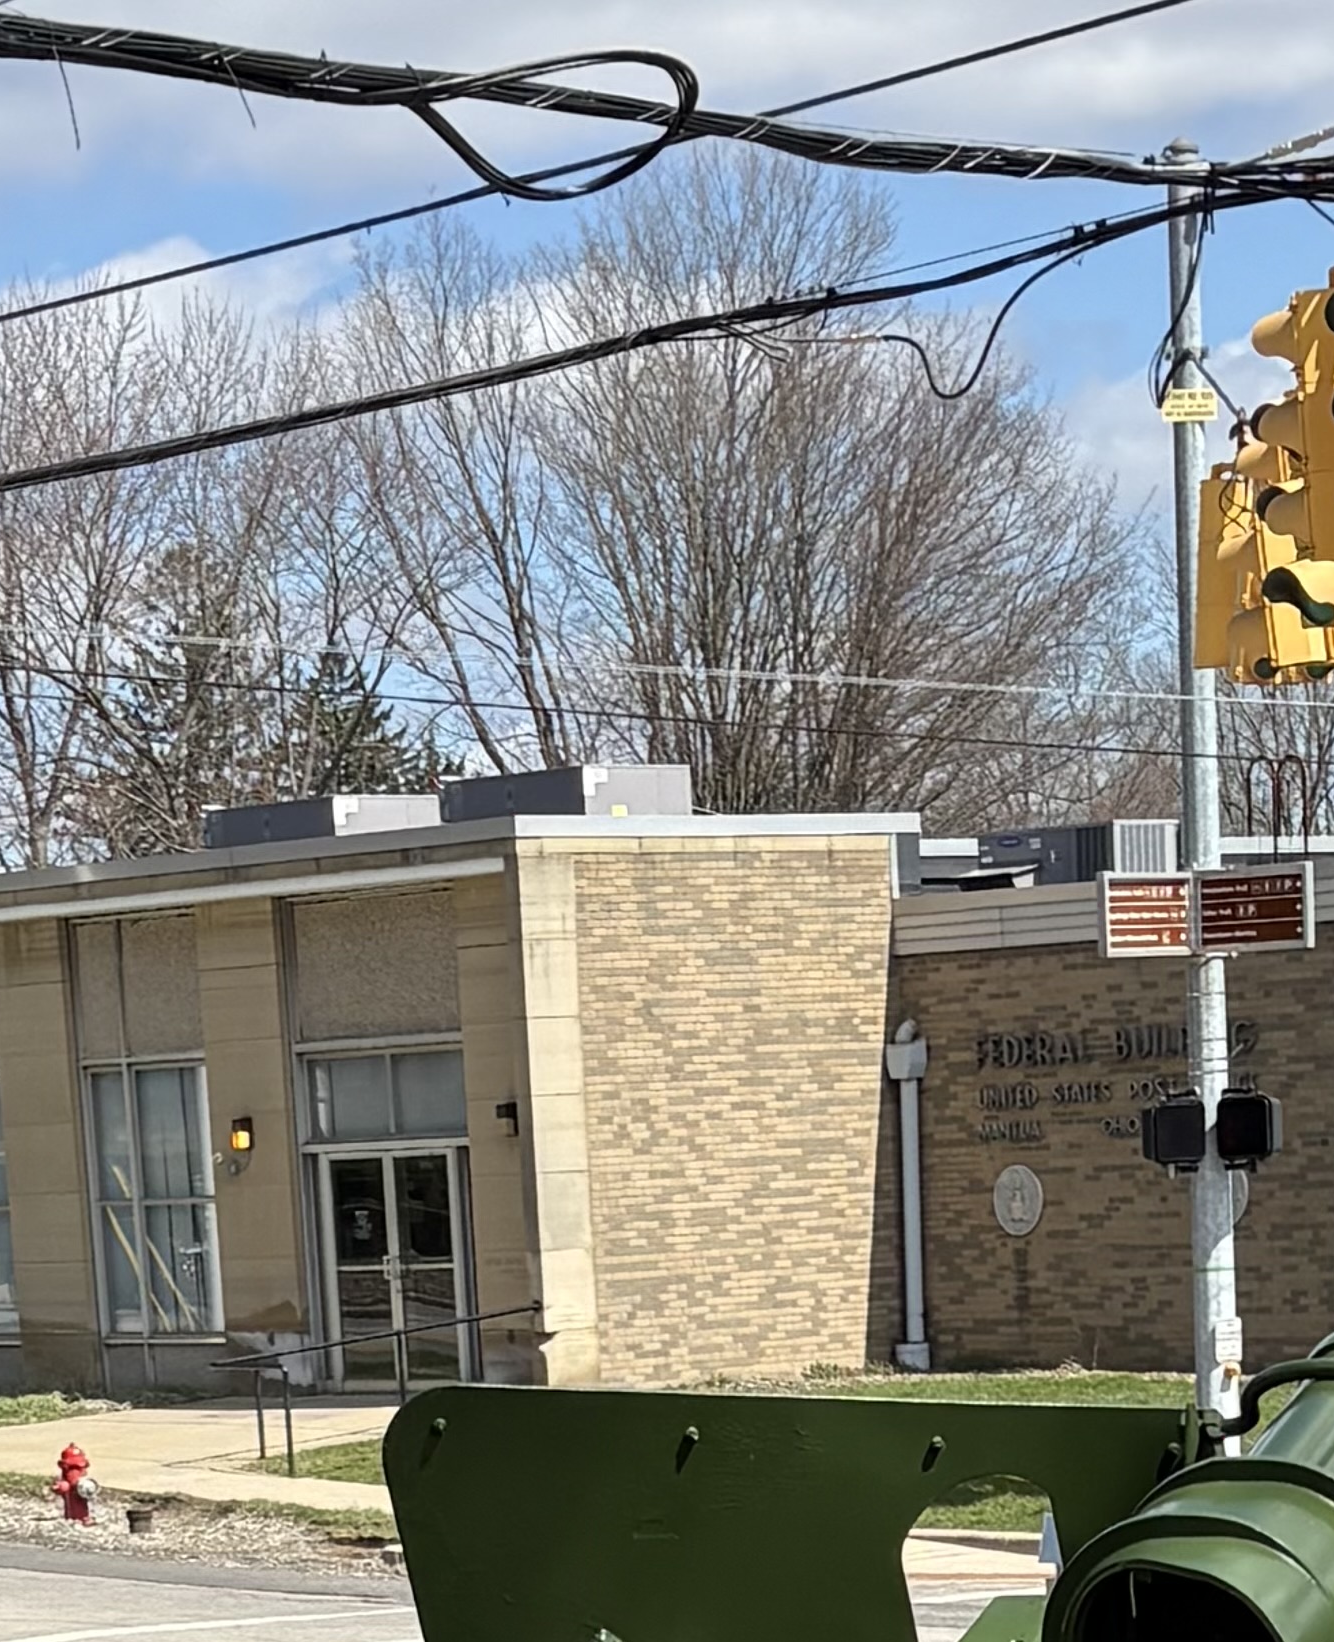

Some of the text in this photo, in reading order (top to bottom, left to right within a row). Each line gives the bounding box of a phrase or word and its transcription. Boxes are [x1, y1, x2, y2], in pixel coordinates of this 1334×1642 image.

[976, 1032, 1087, 1069] FEDERAL
[978, 1082, 1039, 1111] UNITED
[1052, 1080, 1113, 1106] STATES
